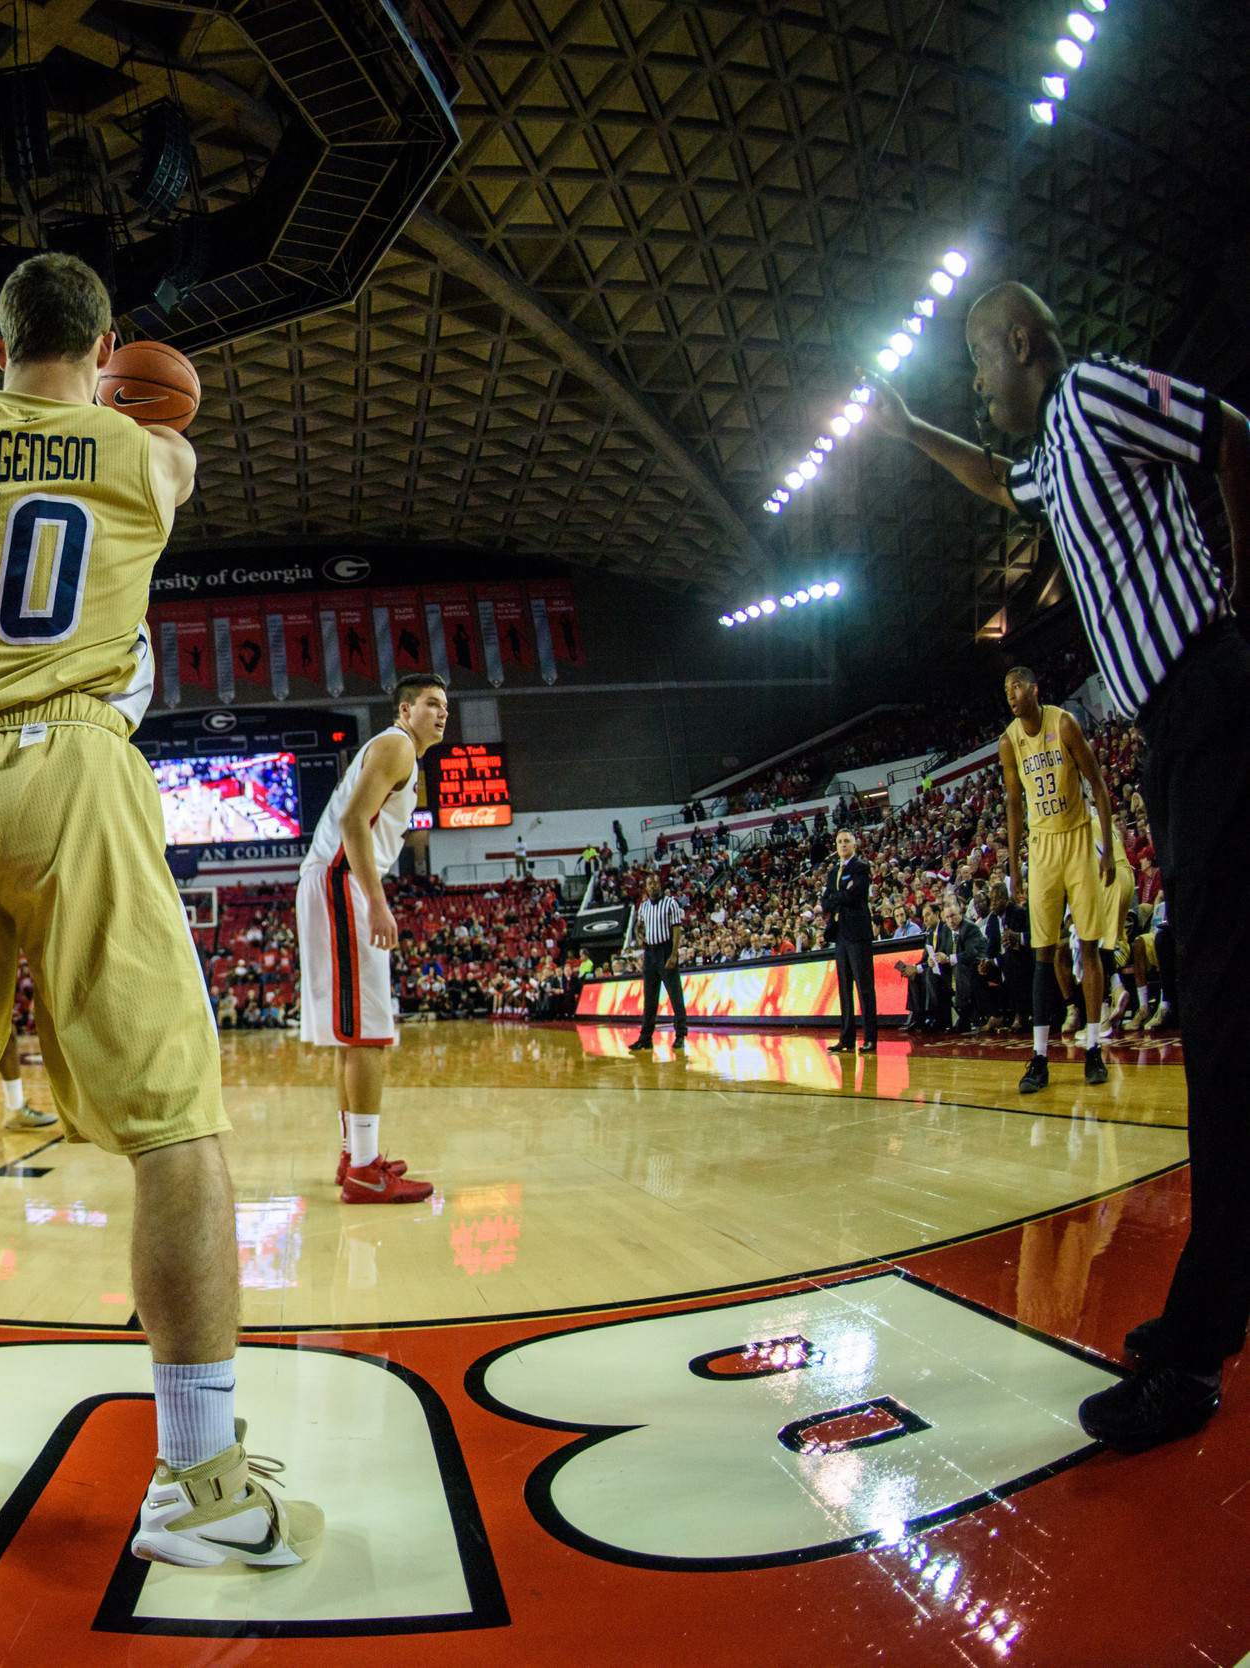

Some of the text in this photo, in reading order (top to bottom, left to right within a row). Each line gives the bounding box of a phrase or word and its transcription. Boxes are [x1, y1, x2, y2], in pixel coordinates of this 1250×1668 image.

[205, 568, 228, 586] of
[231, 564, 314, 584] Georgia
[1022, 750, 1064, 775] GEORGIA
[1034, 772, 1056, 798] 33
[1034, 795, 1068, 817] TECH
